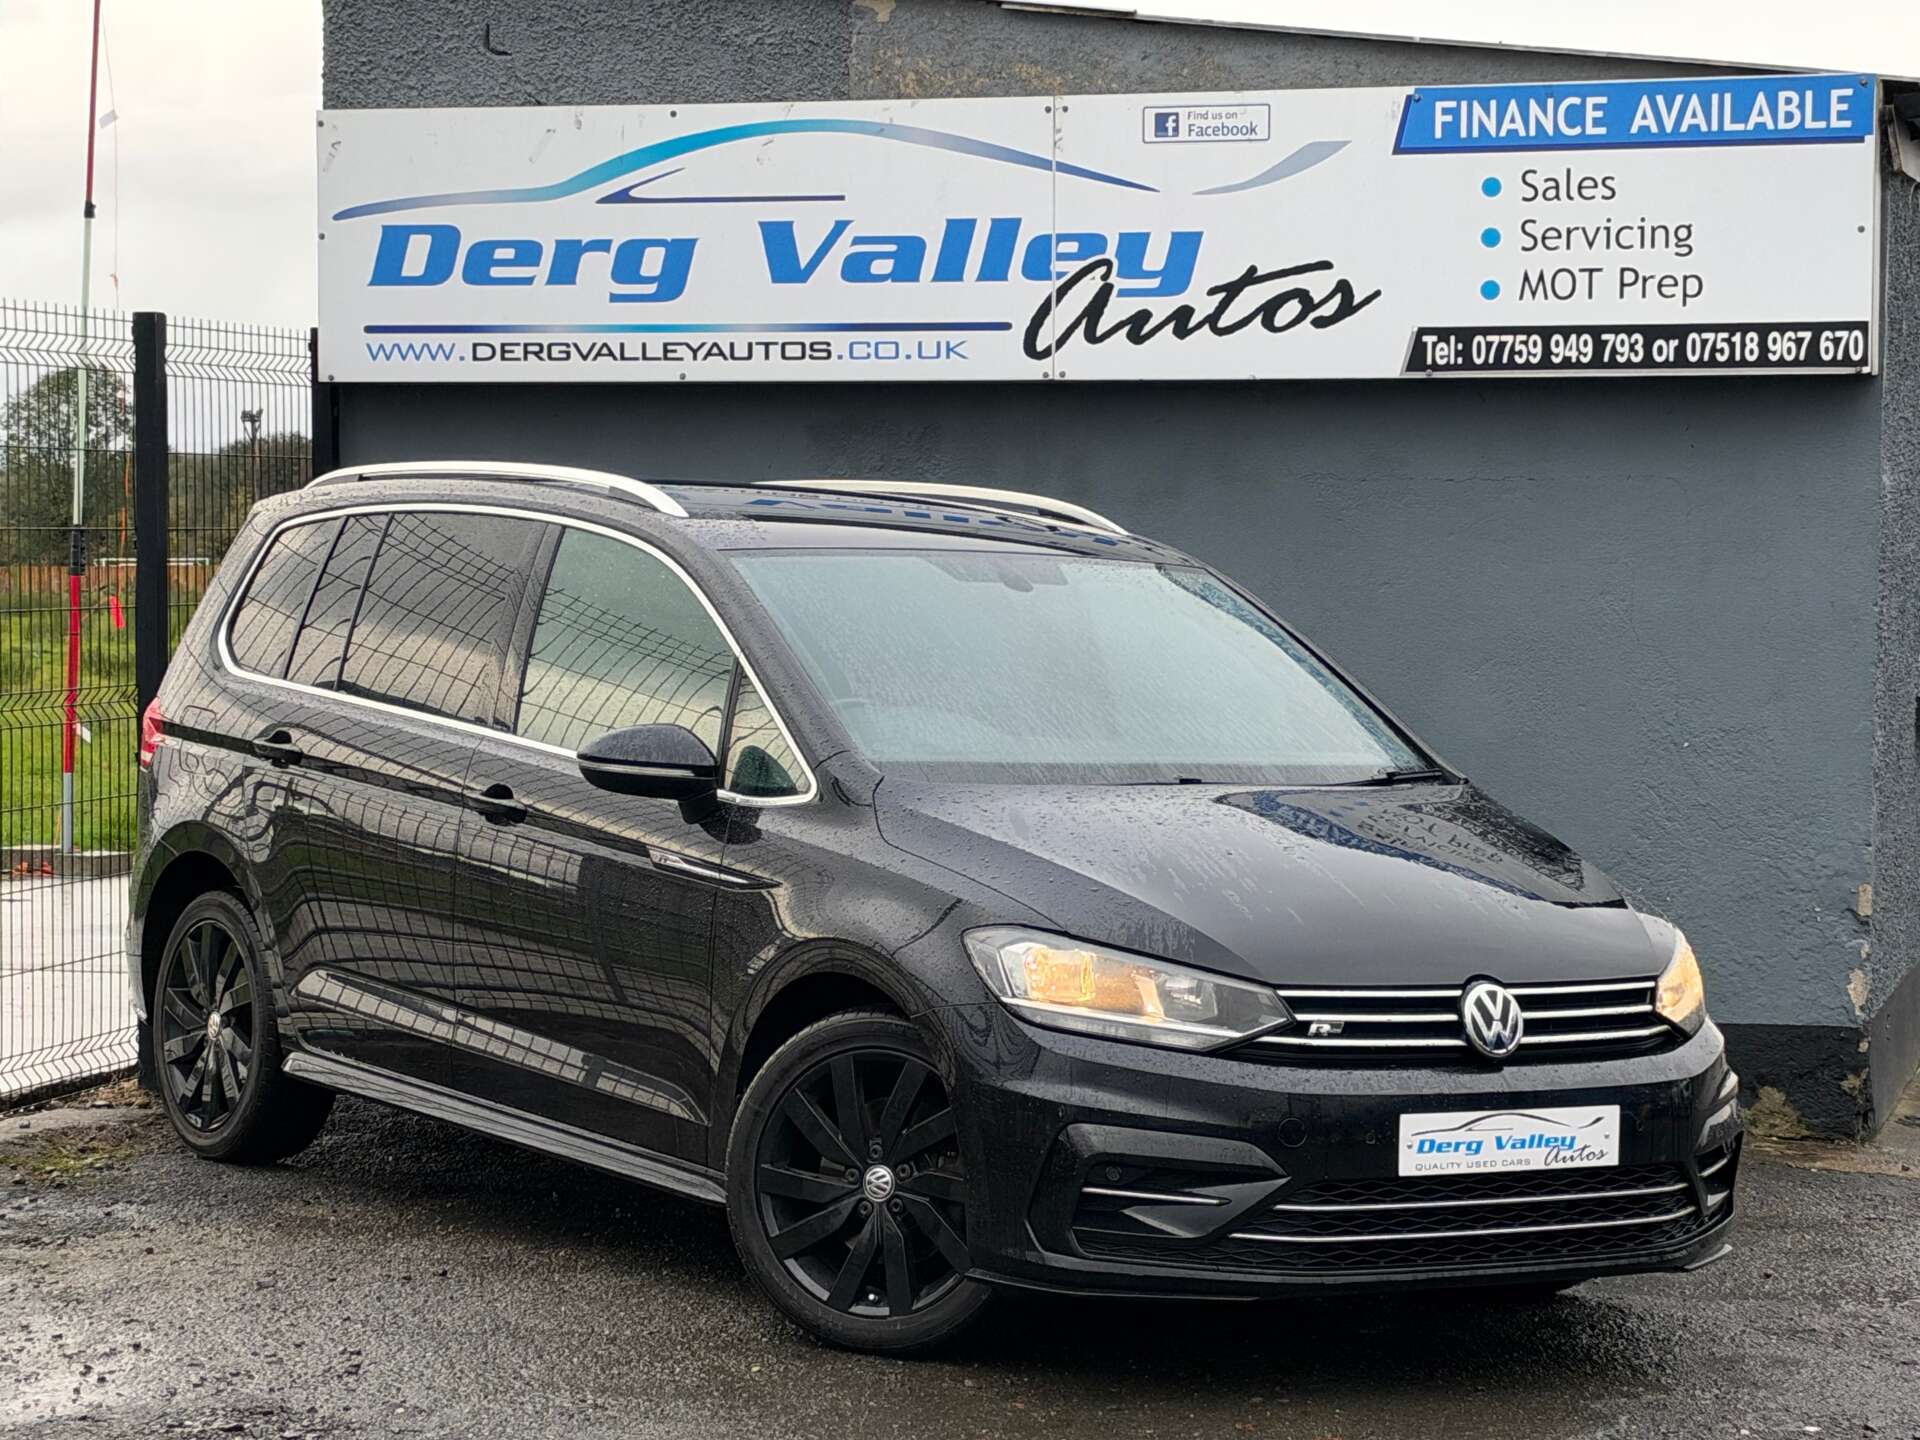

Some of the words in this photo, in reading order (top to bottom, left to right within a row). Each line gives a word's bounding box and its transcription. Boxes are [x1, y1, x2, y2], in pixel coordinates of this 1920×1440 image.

[1187, 110, 1209, 121] Find
[1211, 112, 1223, 120] us
[1225, 111, 1238, 120] on
[1188, 120, 1259, 137] Facebook
[1433, 95, 1608, 139] FINANCE
[1630, 88, 1855, 135] AVAILABLE
[1520, 167, 1617, 203] Sales
[1519, 217, 1694, 257] Servicing
[367, 224, 699, 303] Derg
[757, 217, 1205, 299] Valley
[1518, 267, 1604, 302] MOT
[1618, 267, 1704, 307] Prep
[1422, 335, 1464, 366] Tel:
[1471, 334, 1542, 365] 07759
[1550, 334, 1594, 364] 949
[1601, 333, 1645, 363] 793
[1652, 339, 1680, 363] or
[1685, 331, 1758, 363] 07518
[1767, 331, 1812, 362] 967
[1819, 330, 1864, 362] 670
[1416, 1138, 1484, 1156] Derg
[1494, 1133, 1576, 1151] Valley
[1415, 1162, 1462, 1172] QUALITY
[1466, 1160, 1497, 1169] USED
[1502, 1158, 1531, 1167] CARS
